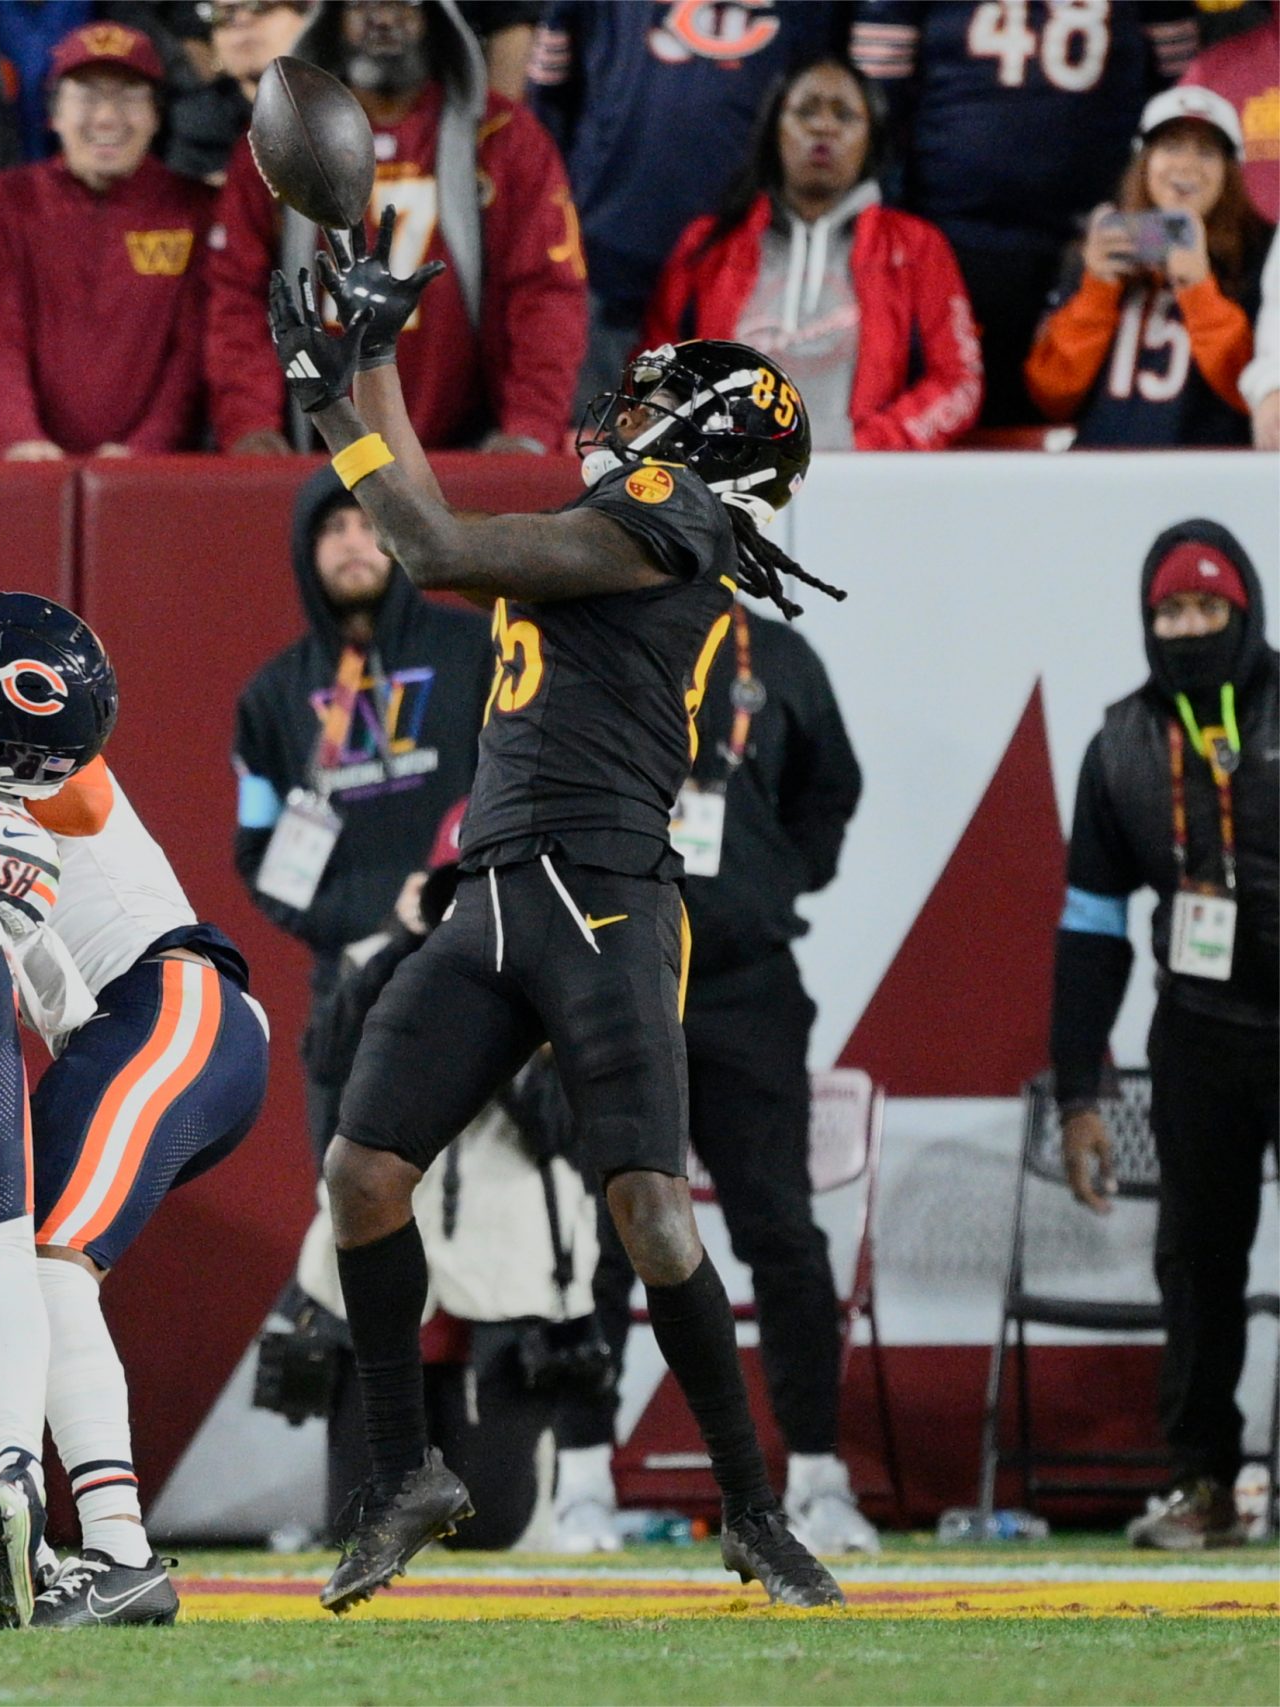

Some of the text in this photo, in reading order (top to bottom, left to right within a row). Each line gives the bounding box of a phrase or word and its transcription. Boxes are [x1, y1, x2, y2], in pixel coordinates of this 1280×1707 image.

[967, 0, 1111, 92] 48
[1108, 288, 1192, 402] 15
[751, 367, 799, 428] 85
